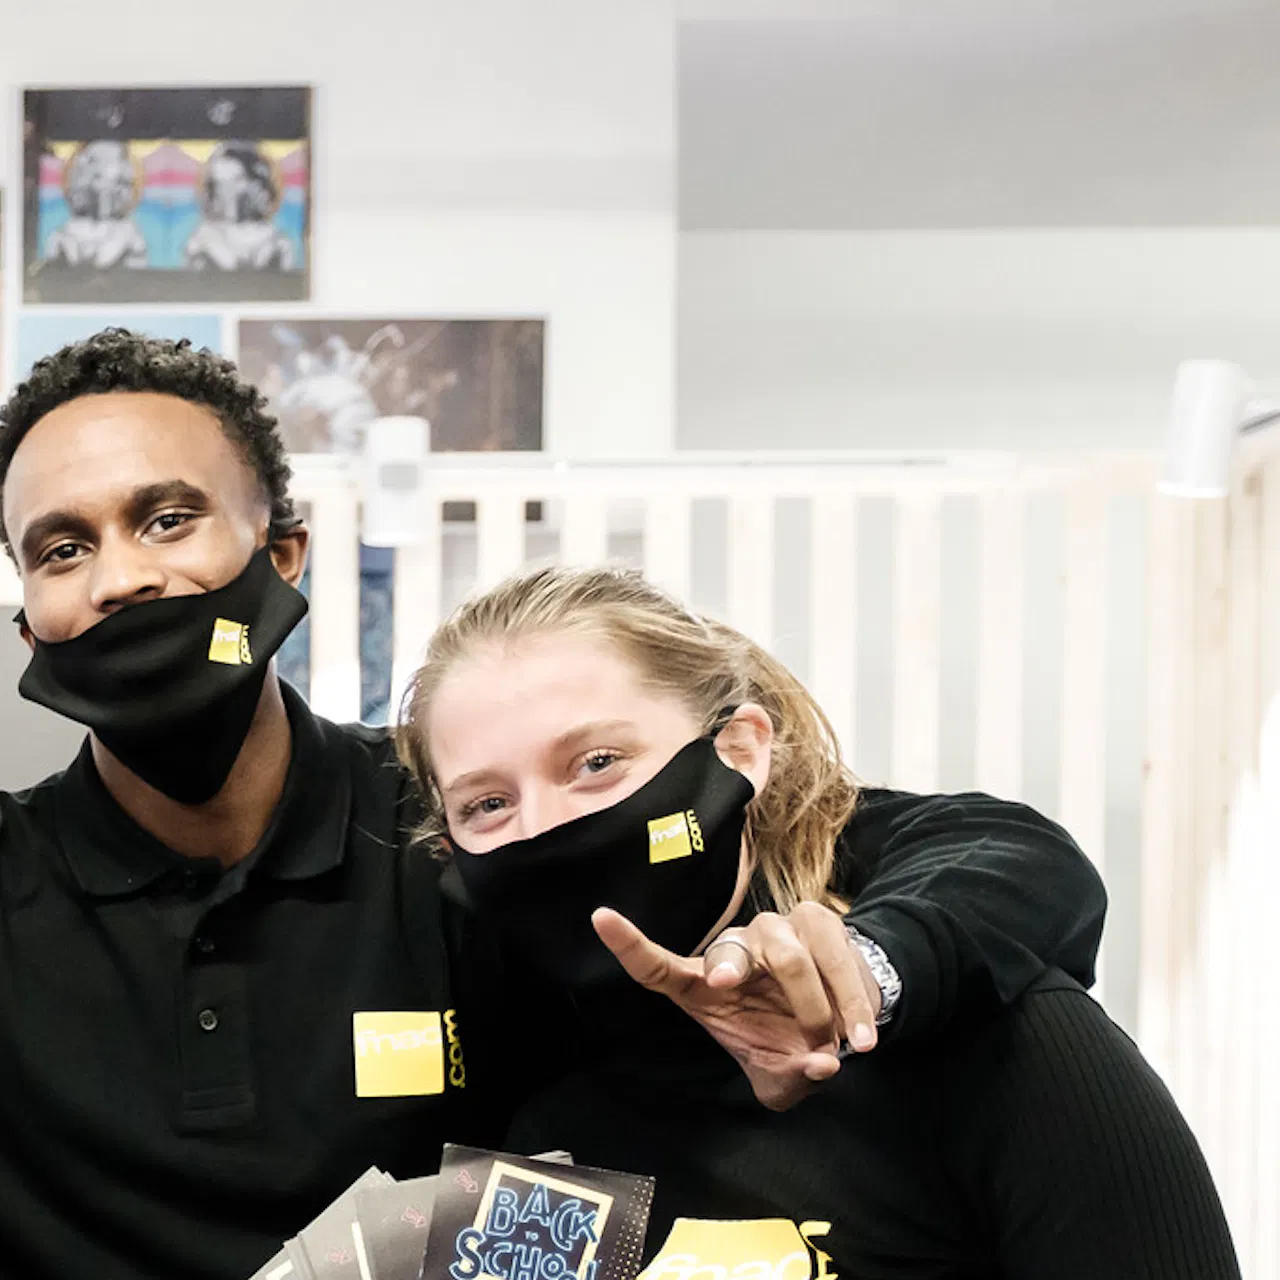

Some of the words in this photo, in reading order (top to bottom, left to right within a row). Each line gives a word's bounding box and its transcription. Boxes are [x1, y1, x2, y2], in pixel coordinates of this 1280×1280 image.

[356, 1025, 443, 1057] fnac
[485, 1183, 600, 1251] BACK
[525, 1230, 539, 1241] TO
